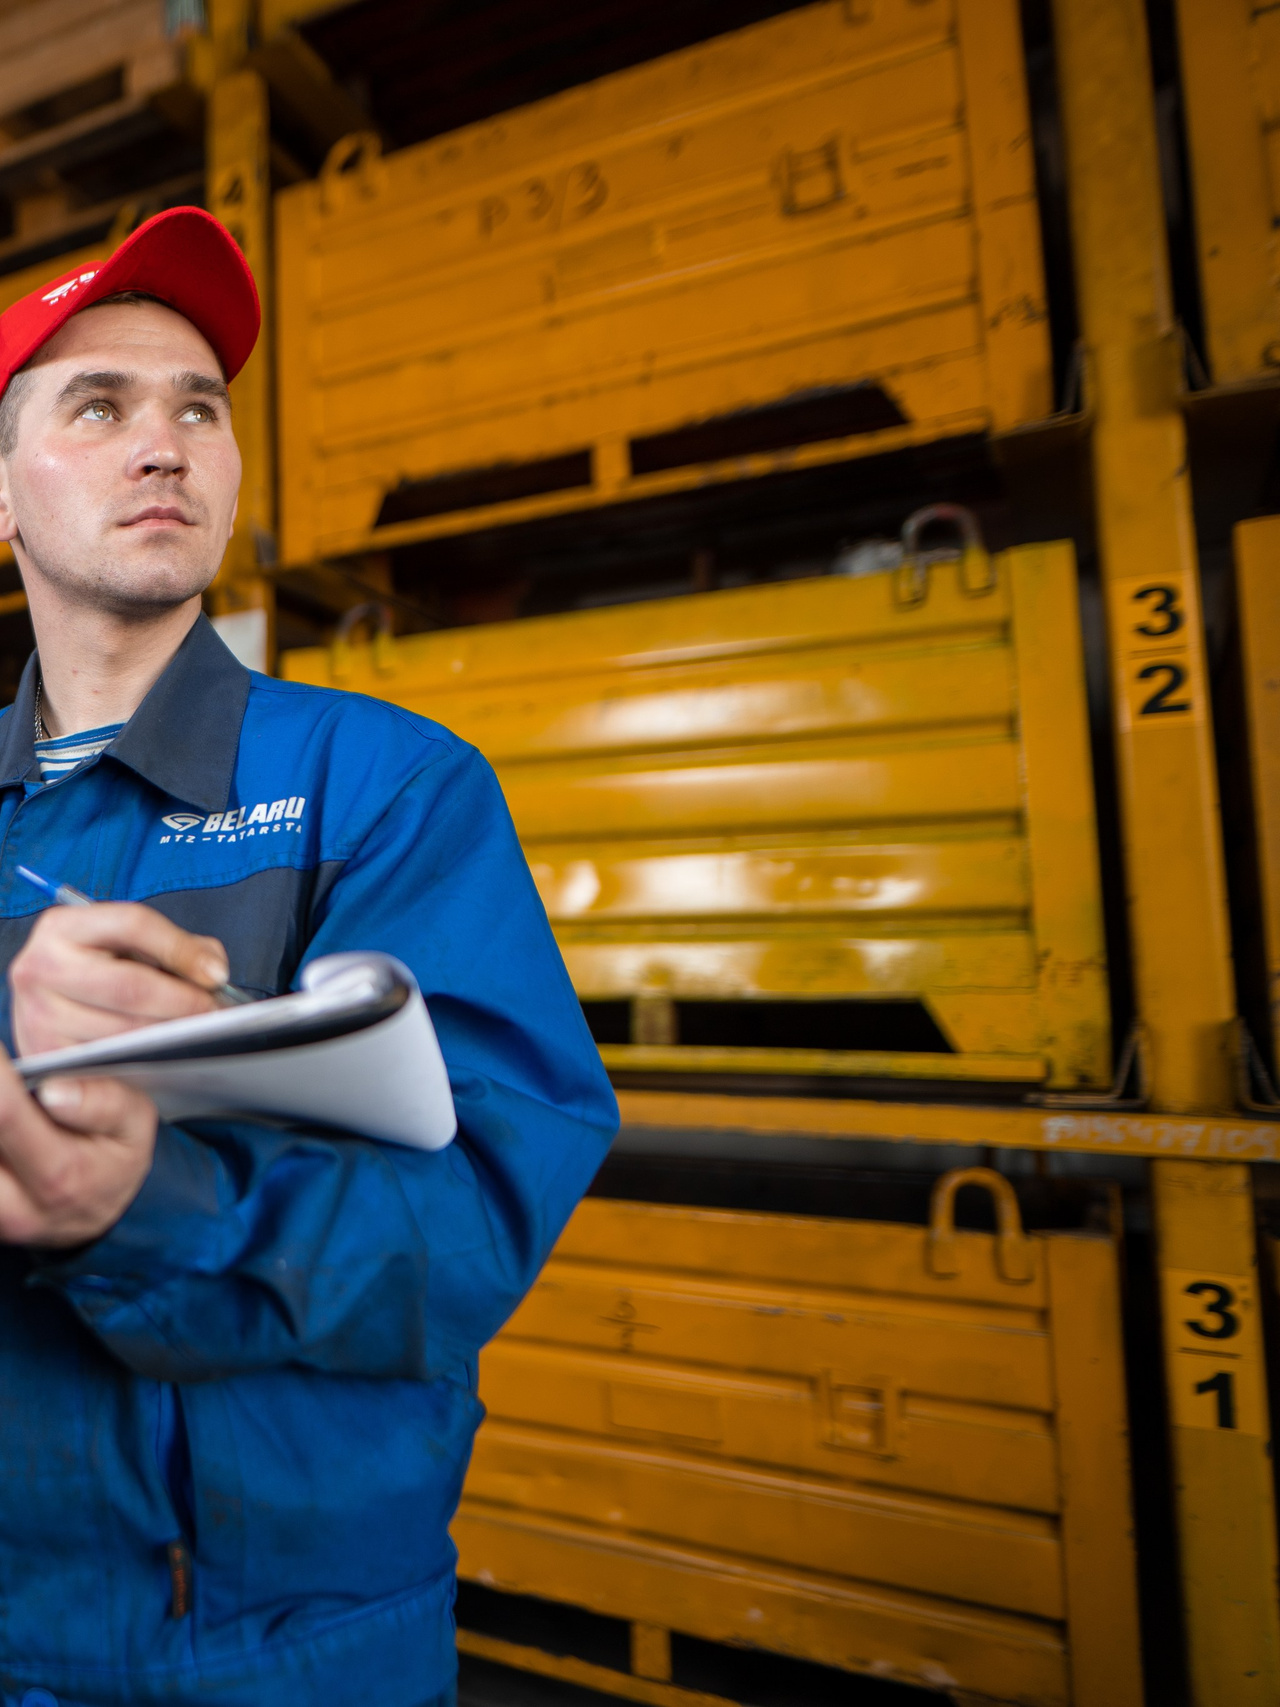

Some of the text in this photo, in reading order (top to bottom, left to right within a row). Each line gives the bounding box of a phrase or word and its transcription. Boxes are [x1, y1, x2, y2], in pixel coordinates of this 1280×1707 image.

[1133, 585, 1183, 638] 3
[1137, 662, 1191, 716] 2
[203, 796, 305, 832] BELARU
[1185, 1280, 1240, 1341] 3
[1194, 1371, 1238, 1430] 1
